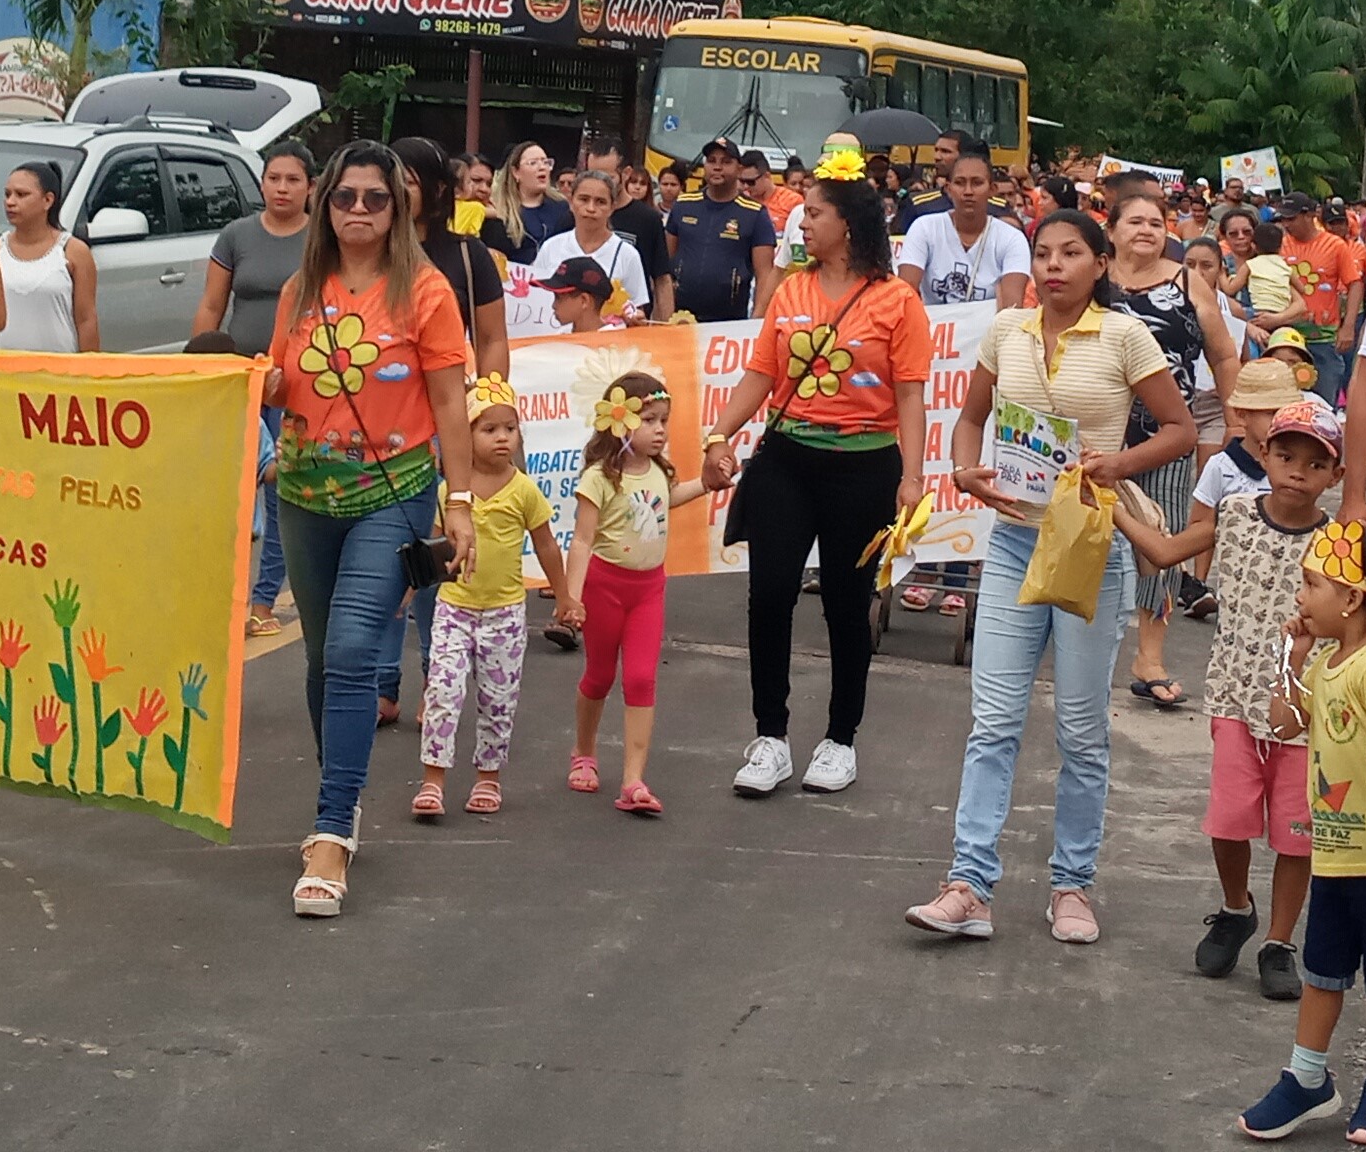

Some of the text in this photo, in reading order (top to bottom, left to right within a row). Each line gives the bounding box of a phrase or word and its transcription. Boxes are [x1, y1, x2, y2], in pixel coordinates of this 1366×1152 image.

[434, 18, 502, 36] 98268-1479
[700, 46, 822, 74] ESCOLAR
[17, 392, 151, 450] MAIO
[59, 475, 143, 511] PELAS
[1315, 827, 1328, 838] DE
[1330, 829, 1351, 840] PAZ
